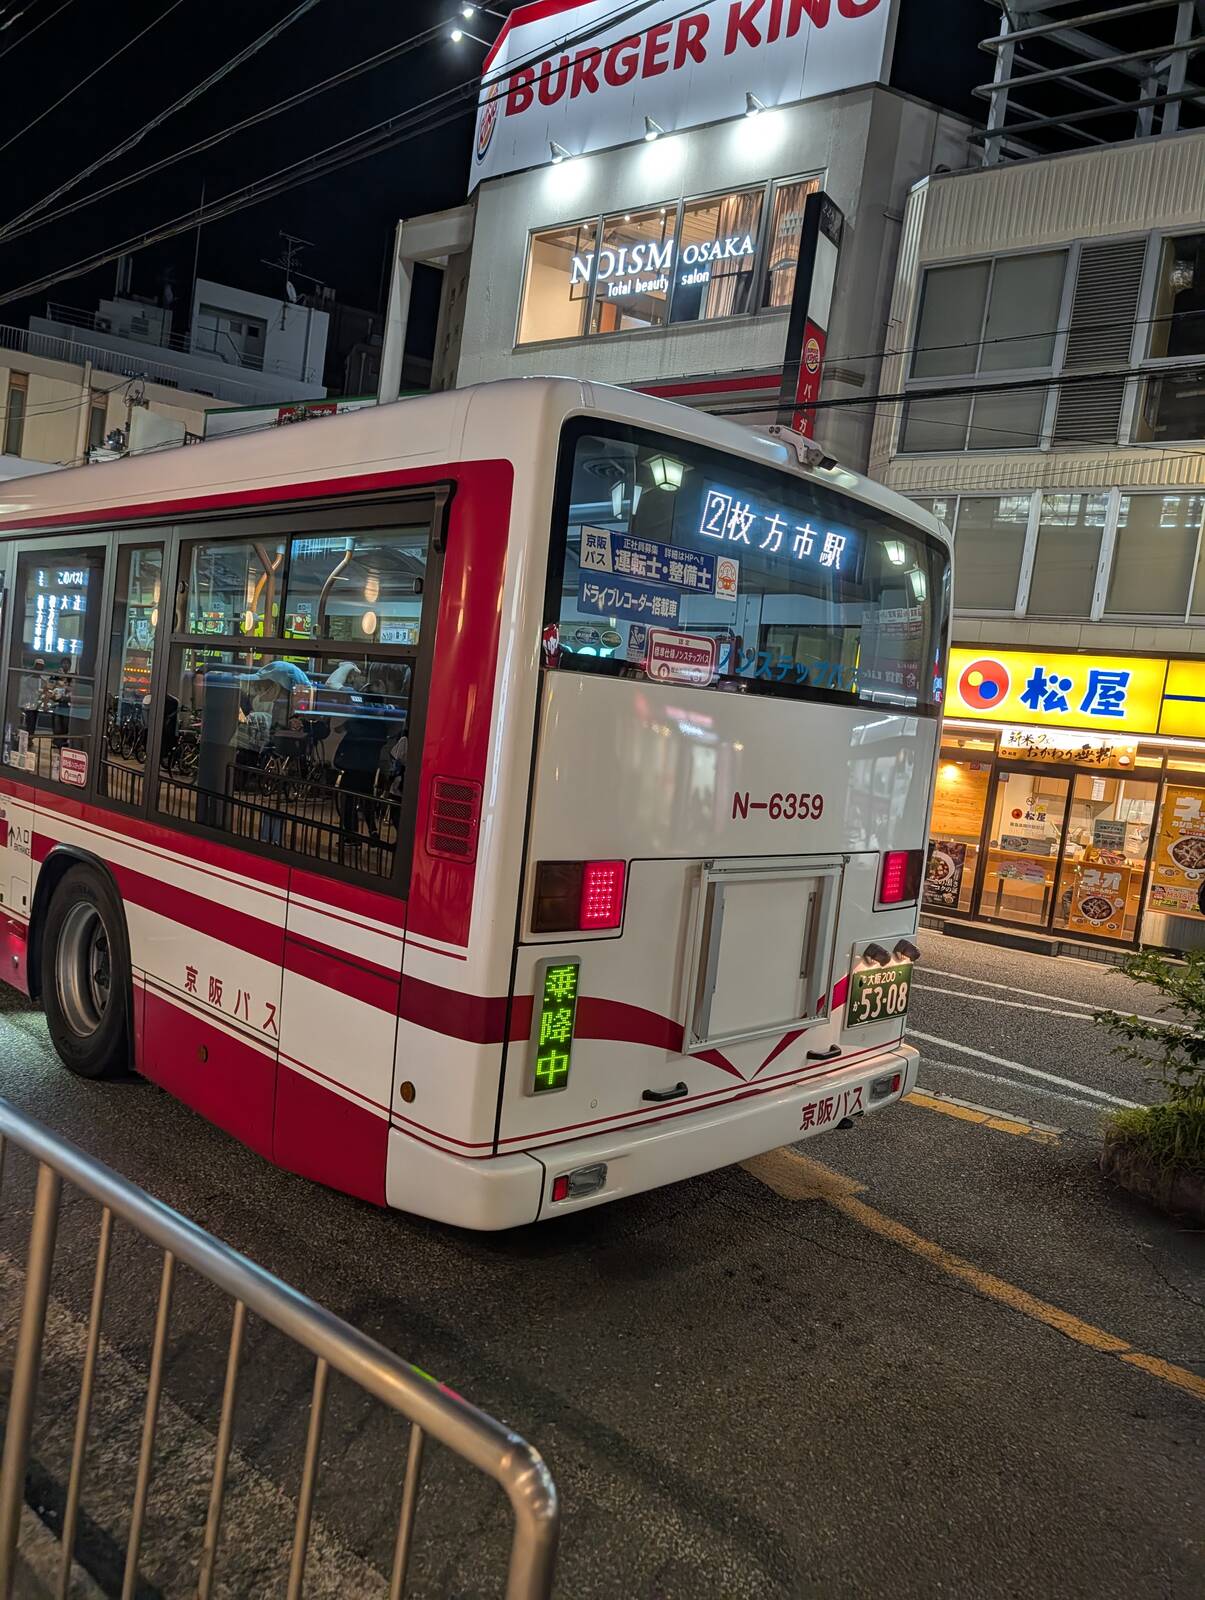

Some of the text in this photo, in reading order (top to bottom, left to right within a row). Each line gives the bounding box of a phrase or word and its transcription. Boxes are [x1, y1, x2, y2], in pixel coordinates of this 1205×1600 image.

[504, 13, 711, 117] BURGER
[569, 234, 754, 286] NOISM OSAKA
[607, 270, 710, 297] Total beauty salon
[584, 551, 606, 566] バス
[585, 533, 607, 550] 京阪
[614, 549, 712, 590] 運転士・整備士
[582, 582, 678, 619] ドライブレコーダー搭載車
[1020, 667, 1130, 717] 松屋
[1027, 743, 1116, 764] おかわり無料
[732, 792, 824, 820] N-6359
[1024, 811, 1046, 822] 松屋
[16, 827, 30, 844] 入口
[184, 966, 279, 1035] 京阪バス
[535, 965, 577, 1085] 乗降中
[799, 1086, 864, 1131] 京阪バス
